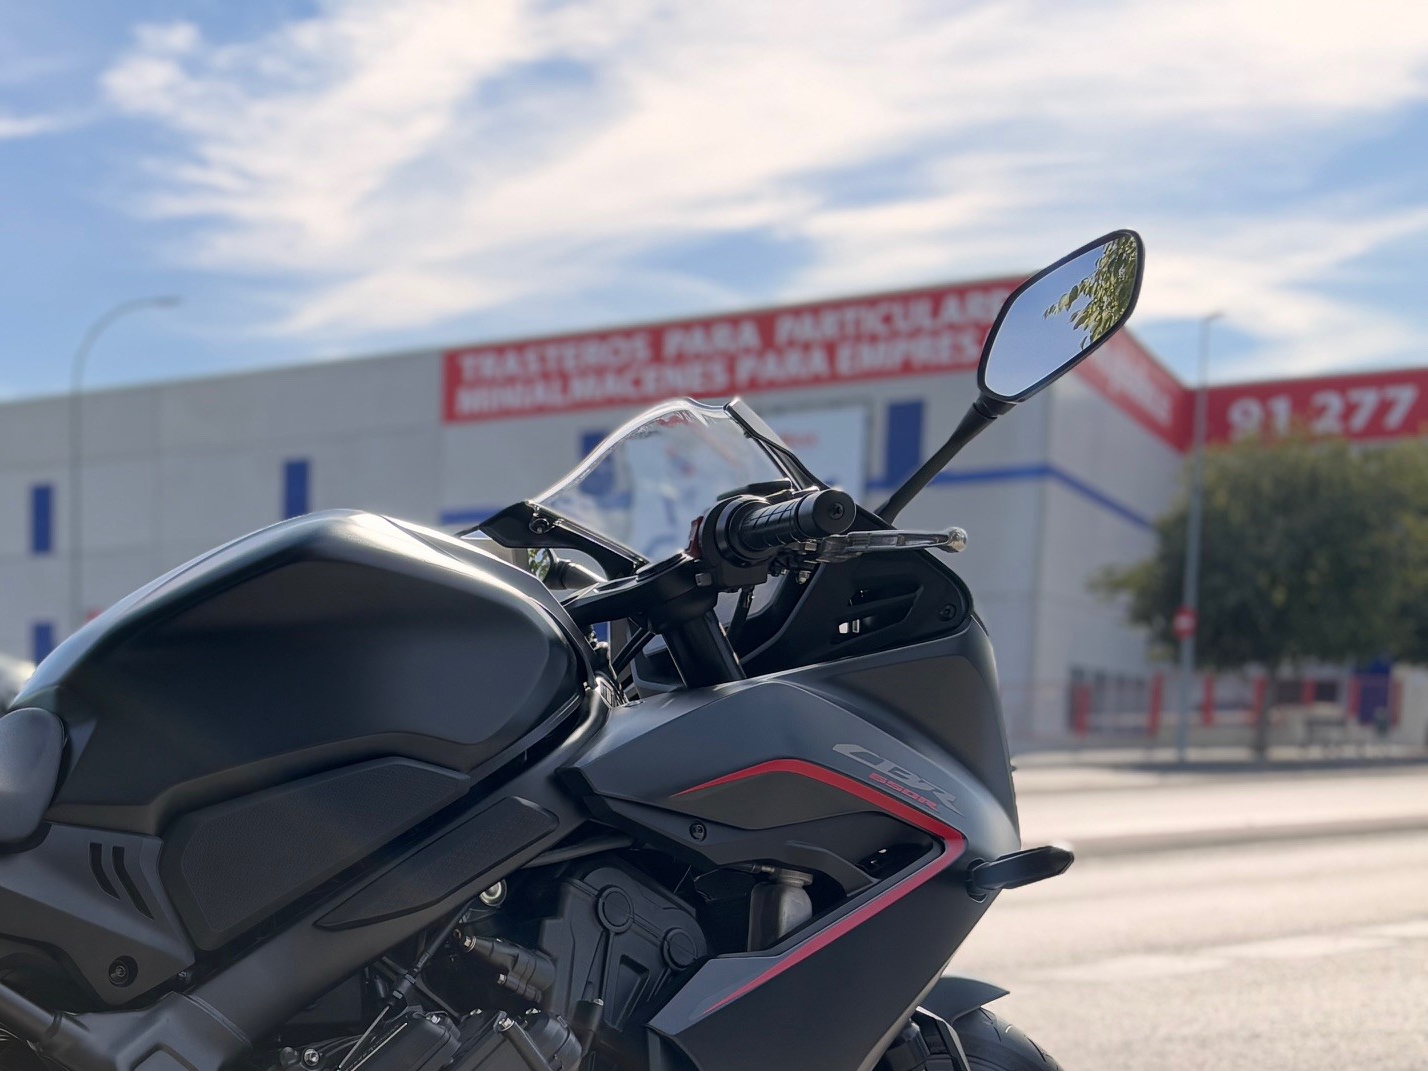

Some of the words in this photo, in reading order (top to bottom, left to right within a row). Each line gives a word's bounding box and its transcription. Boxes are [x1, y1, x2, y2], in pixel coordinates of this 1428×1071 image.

[459, 331, 649, 381] TRASTEROS
[664, 319, 761, 359] PARA
[735, 347, 832, 387] PARA
[1227, 395, 1293, 441] 91
[1310, 384, 1419, 435] 277
[833, 743, 966, 819] CBR
[869, 772, 939, 812] 650R
